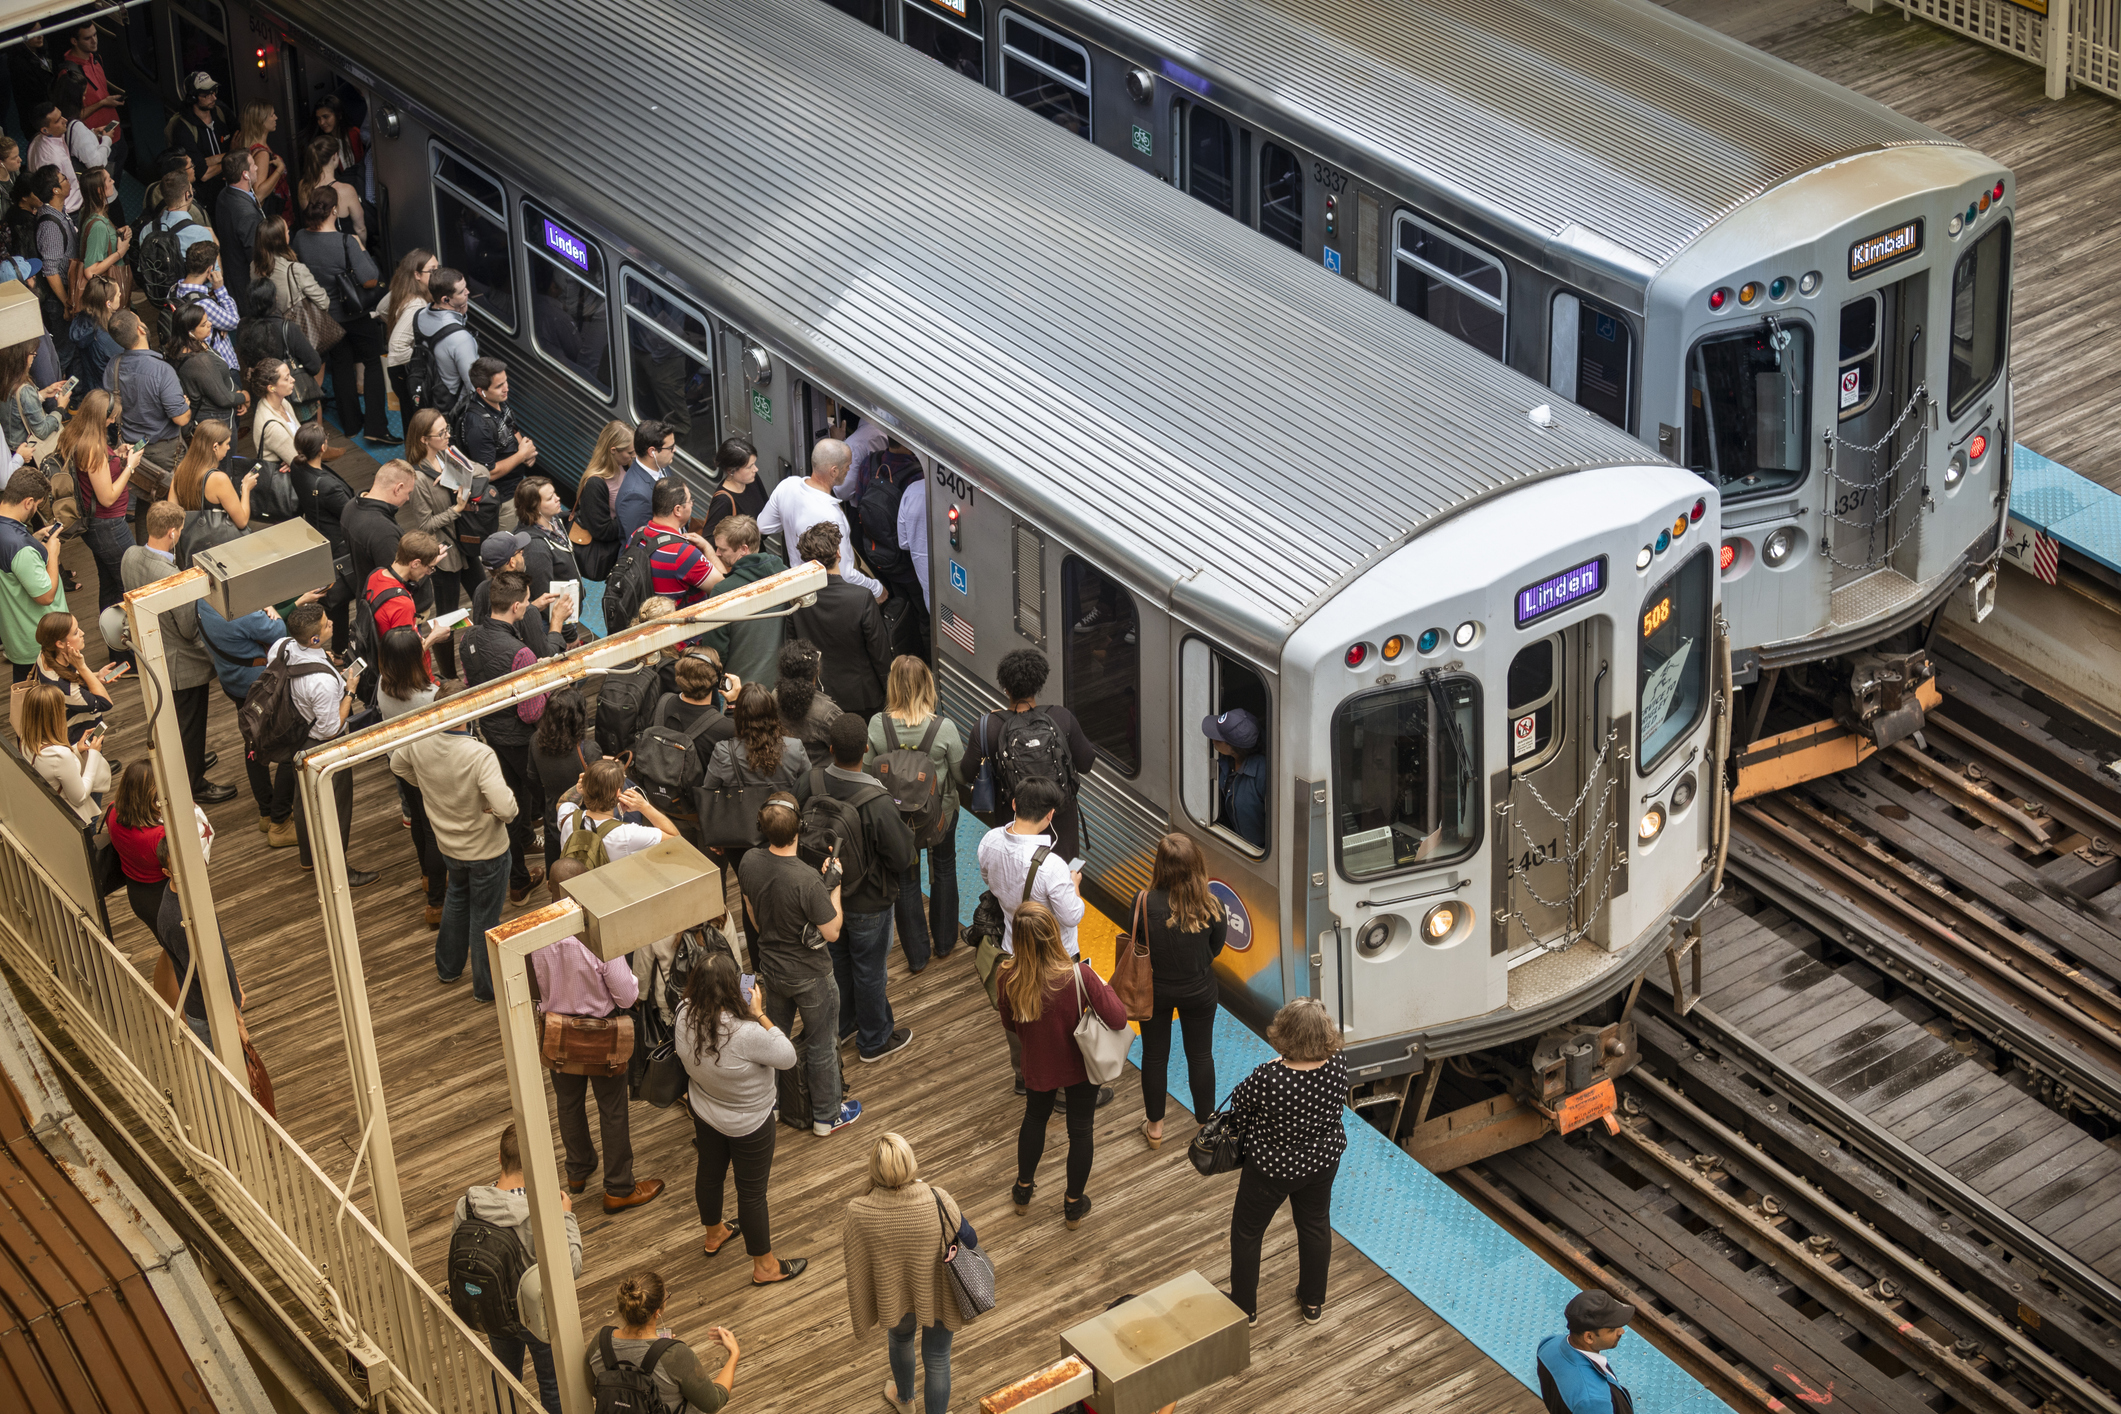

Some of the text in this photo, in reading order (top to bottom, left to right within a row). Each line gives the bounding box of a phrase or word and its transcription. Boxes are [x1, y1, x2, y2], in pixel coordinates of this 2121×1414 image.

[249, 14, 273, 44] 5401
[1314, 162, 1348, 195] 3337
[549, 227, 586, 265] Linden
[1853, 225, 1914, 266] Kimball
[936, 463, 974, 507] 5401
[1835, 487, 1868, 515] 337
[1526, 571, 1593, 612] Linden
[1644, 598, 1669, 637] 508
[1224, 904, 1245, 934] ta
